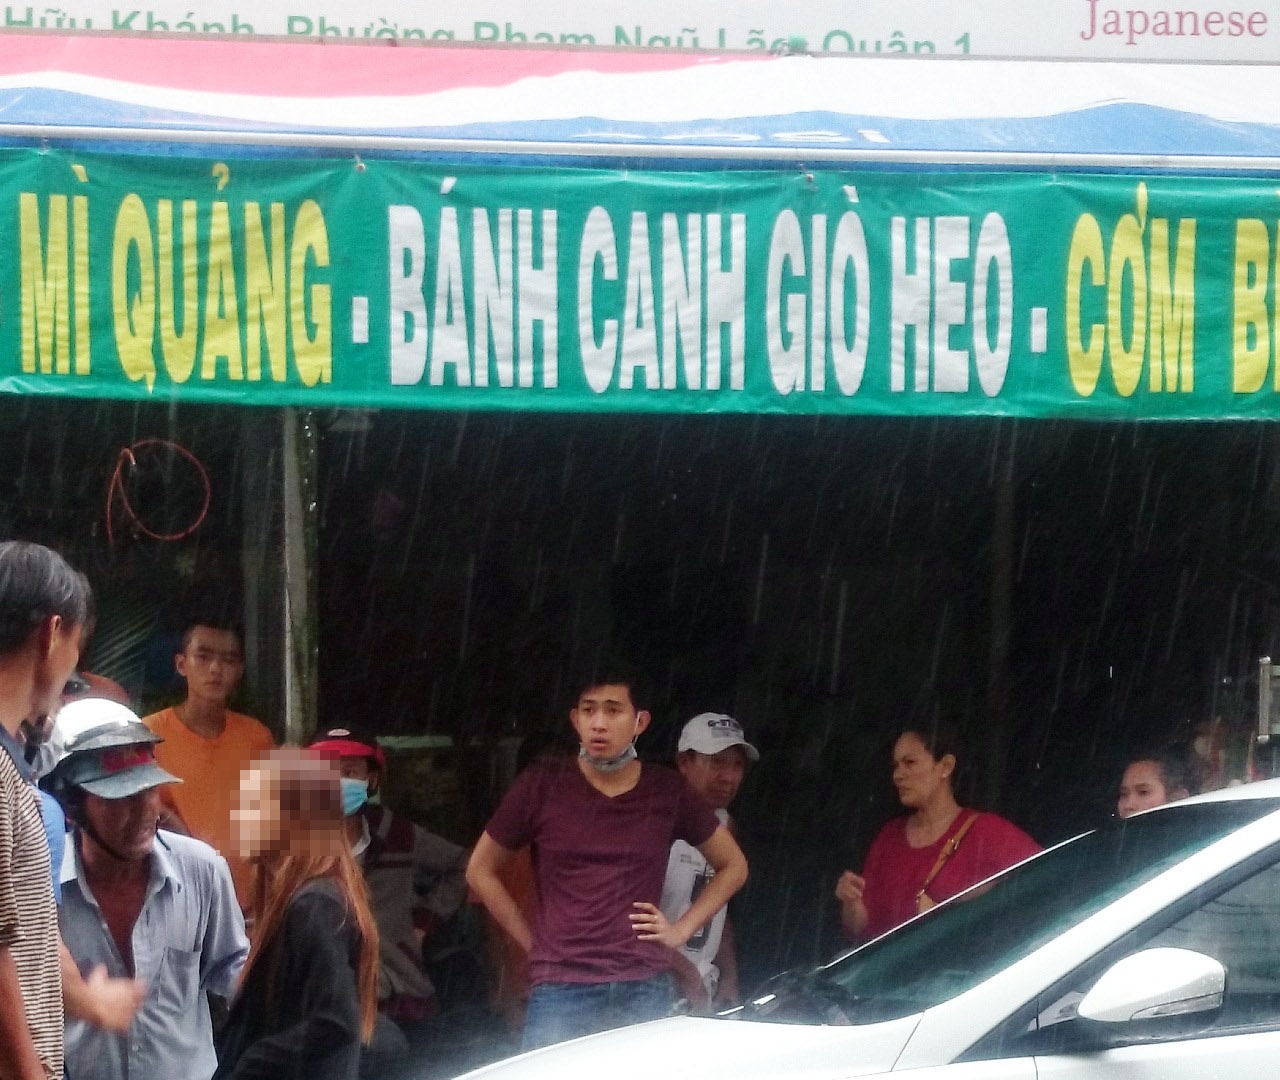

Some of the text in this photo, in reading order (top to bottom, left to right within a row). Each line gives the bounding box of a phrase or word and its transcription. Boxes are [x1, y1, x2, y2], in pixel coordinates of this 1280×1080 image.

[1081, 0, 1268, 45] Japanese
[19, 163, 91, 376] MÌ
[111, 161, 333, 394] QUẢNG
[387, 175, 559, 389] BÁNH
[577, 205, 747, 394] CANH
[765, 184, 871, 396] GIÒ
[890, 211, 1014, 398] HEO
